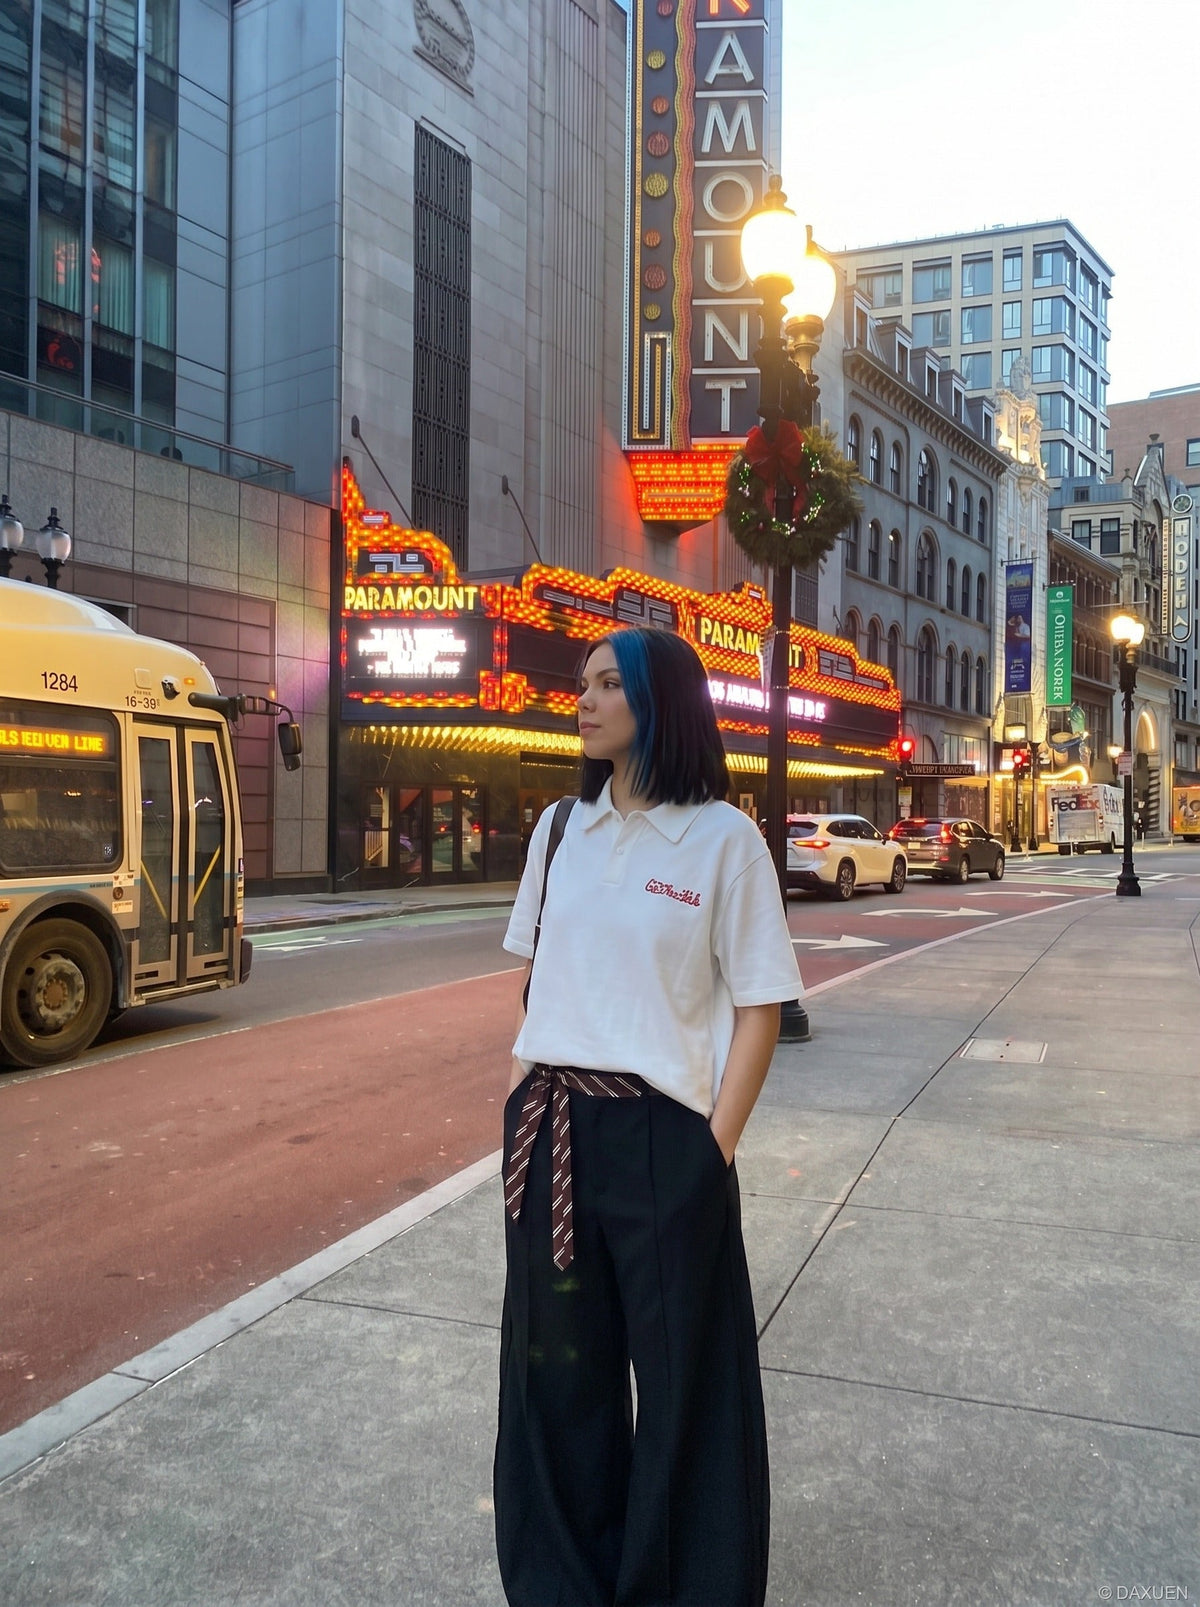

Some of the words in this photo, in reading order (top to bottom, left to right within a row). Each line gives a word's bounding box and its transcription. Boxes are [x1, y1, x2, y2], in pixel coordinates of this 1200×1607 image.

[701, 0, 756, 432] AMOUNT
[344, 586, 478, 611] PARAMOUNT
[41, 671, 78, 692] 1284
[125, 695, 157, 709] 16-39
